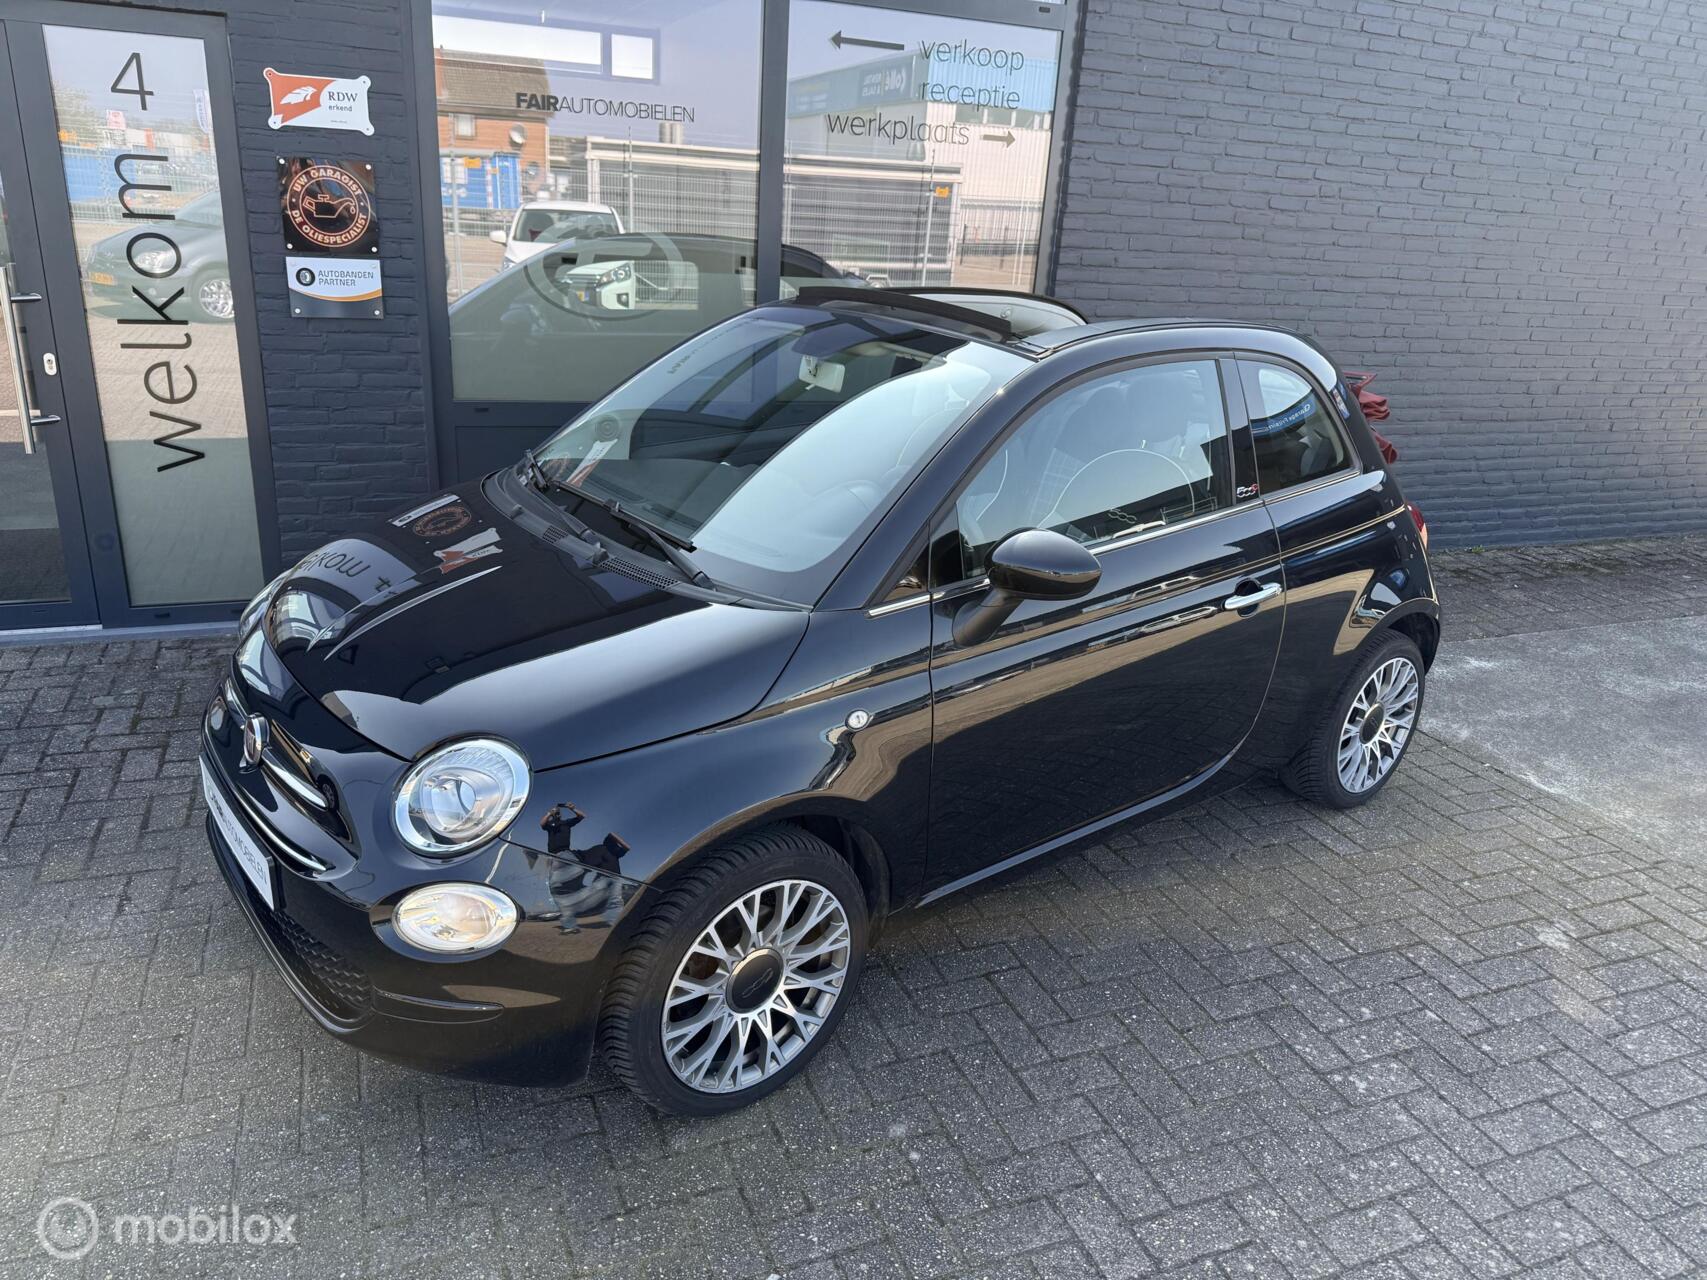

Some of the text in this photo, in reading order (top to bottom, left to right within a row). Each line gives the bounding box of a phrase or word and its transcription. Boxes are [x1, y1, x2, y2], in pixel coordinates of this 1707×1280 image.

[921, 39, 1024, 76] verkoop
[110, 52, 154, 111] 4
[328, 91, 358, 102] RDW
[922, 81, 1020, 112] receptie
[515, 92, 695, 123] FAIRAUTOMOBIELEN
[827, 113, 970, 145] werkplaats
[293, 167, 362, 196] UW GARAGIST
[291, 209, 367, 245] DE OLIESPECIALIST
[317, 270, 374, 280] AUTOBANDEN
[318, 278, 356, 287] PARTNER
[114, 153, 205, 472] welkom
